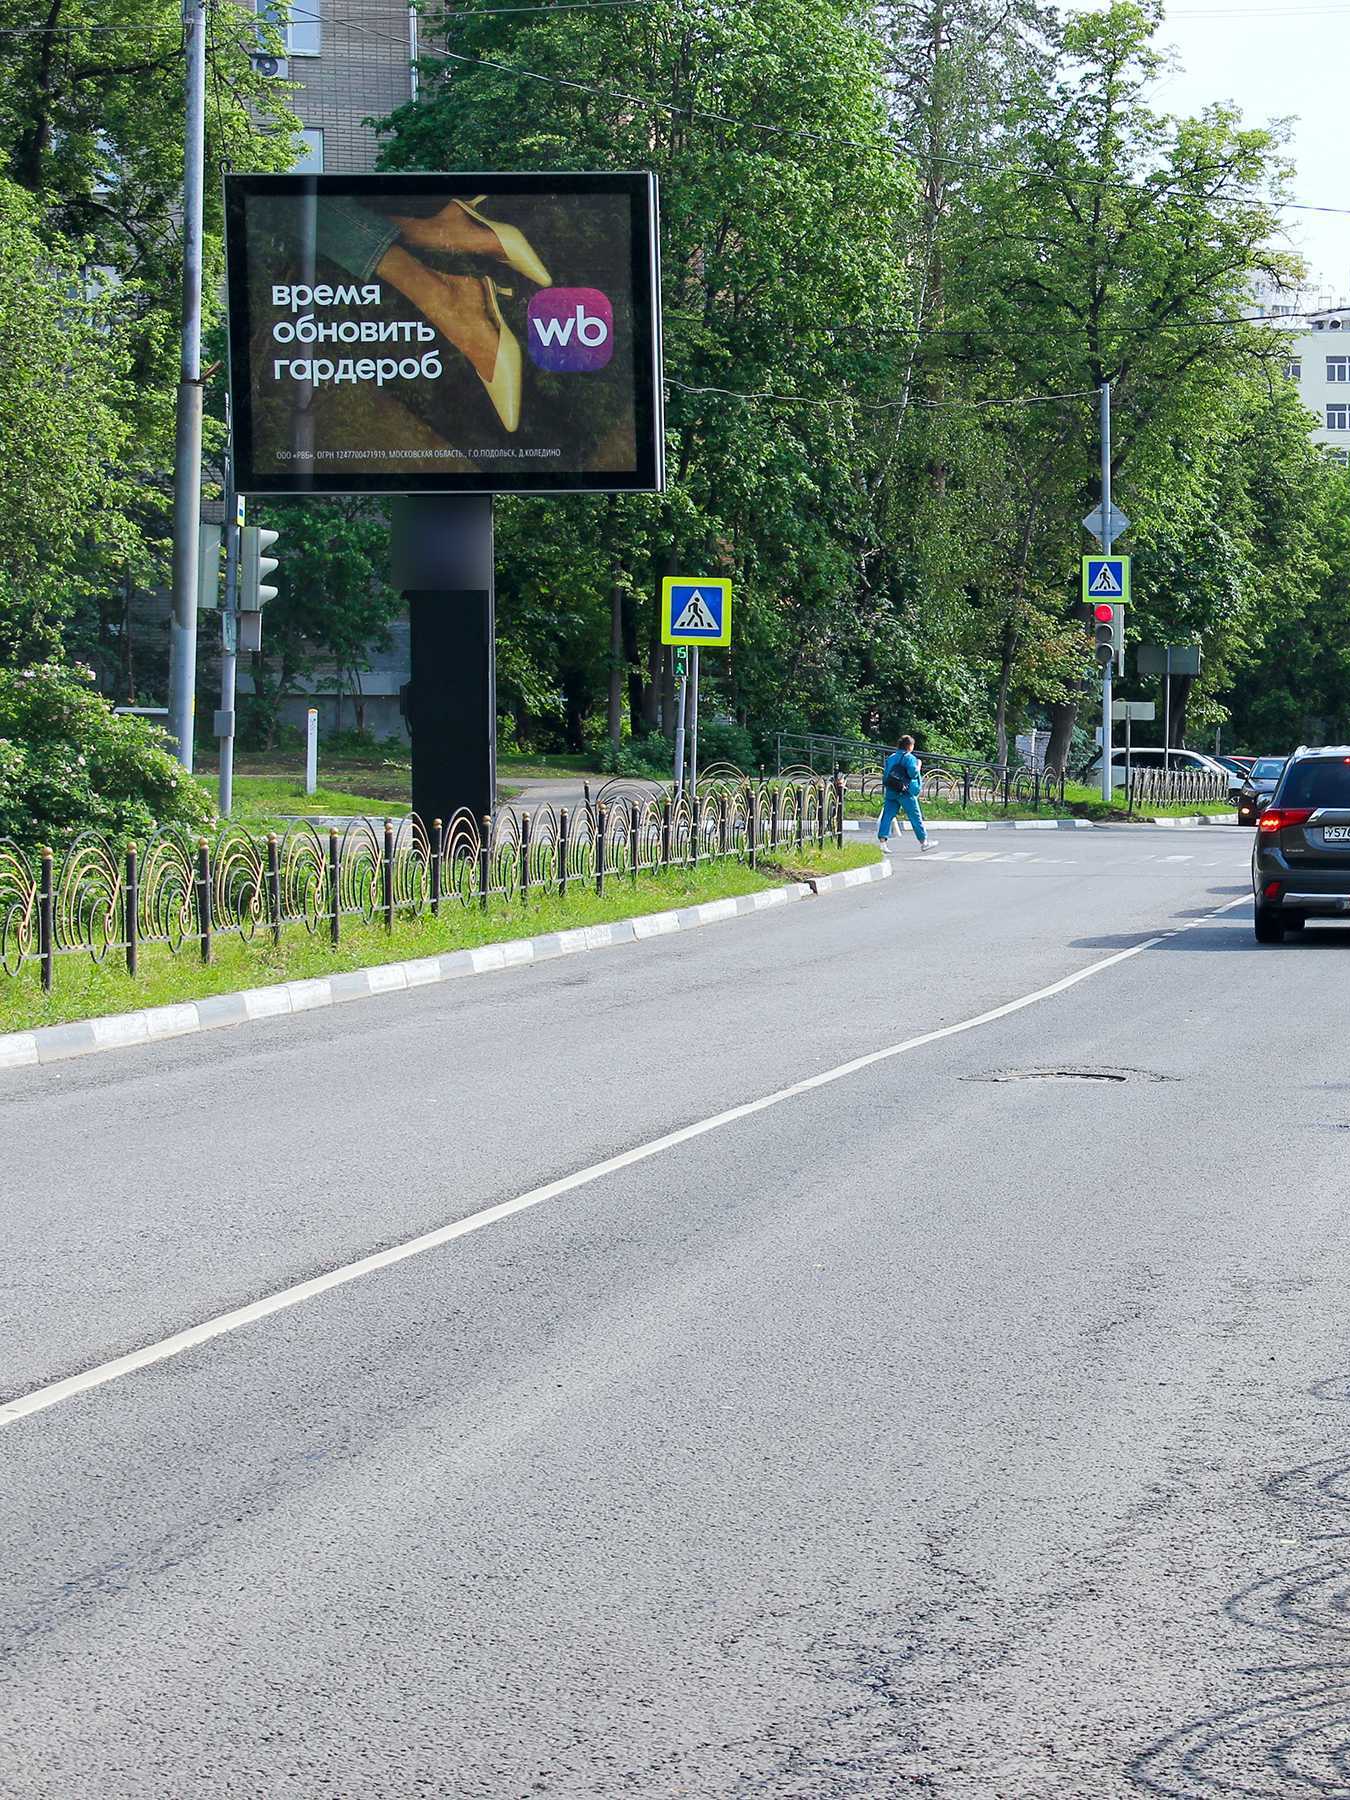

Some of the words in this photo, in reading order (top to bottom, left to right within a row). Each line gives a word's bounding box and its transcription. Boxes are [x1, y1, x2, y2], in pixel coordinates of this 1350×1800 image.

[271, 284, 381, 312] время
[272, 313, 436, 344] обновить
[532, 304, 609, 348] wb
[273, 349, 443, 387] гардероб
[388, 449, 433, 459] МОСКОВСКАЯ
